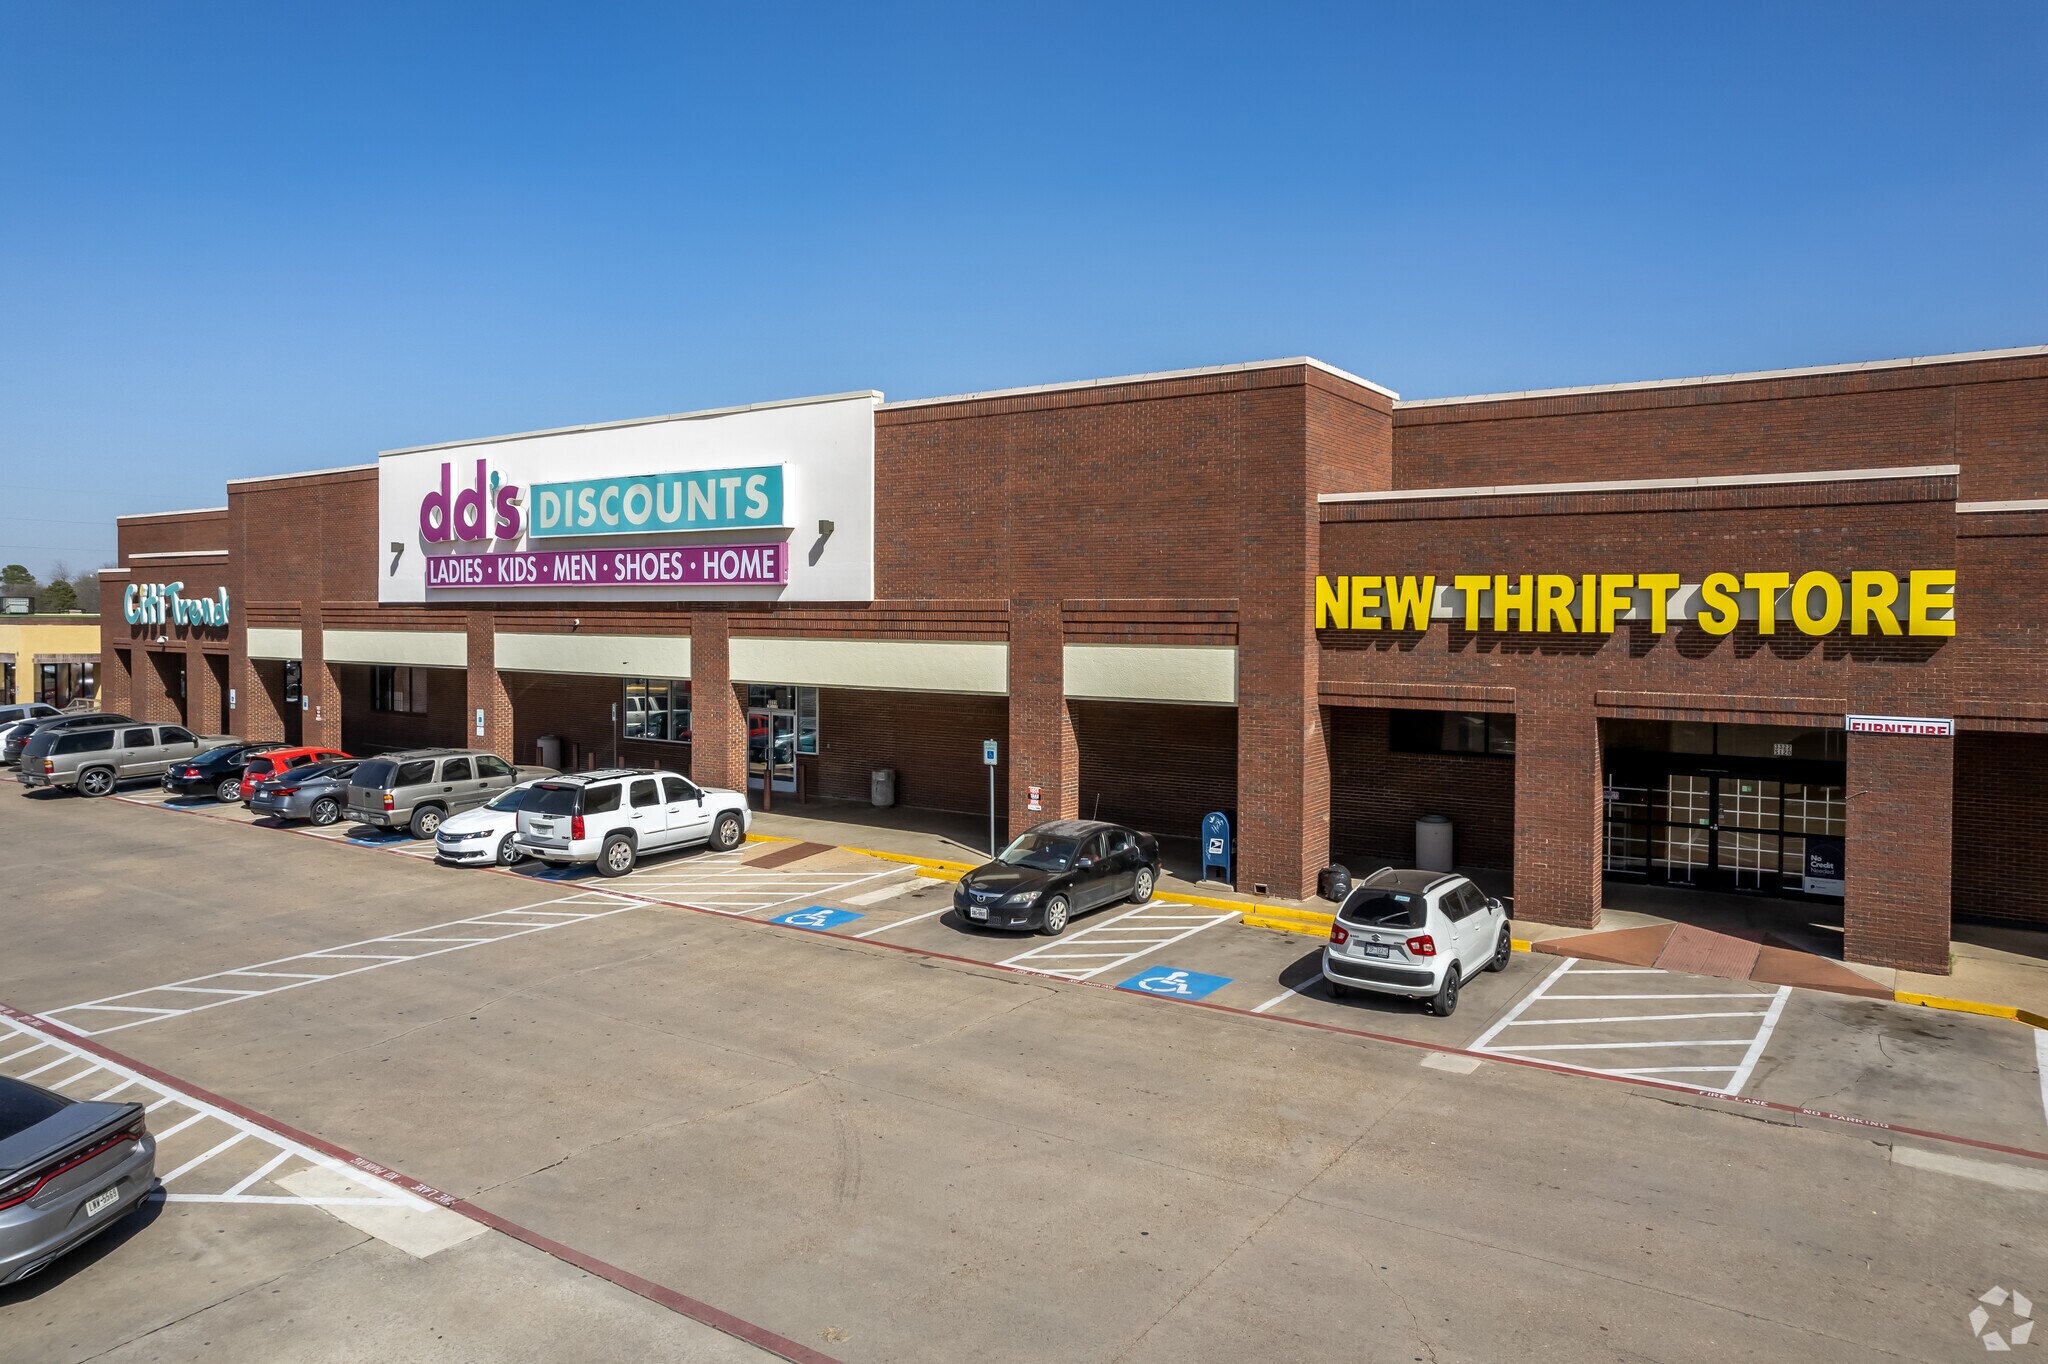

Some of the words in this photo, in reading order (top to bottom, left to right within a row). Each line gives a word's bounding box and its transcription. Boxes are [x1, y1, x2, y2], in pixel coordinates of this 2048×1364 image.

[420, 458, 524, 543] dd's
[540, 474, 769, 529] DISCOUNTS
[430, 558, 483, 583] LADIES
[498, 556, 537, 582] KIDS
[553, 554, 597, 582] MEN
[614, 552, 683, 581] SHOES
[703, 550, 775, 580] HOME
[124, 583, 165, 625] Citi
[1315, 575, 1436, 631] NEW
[1454, 574, 1680, 634] THRIFT
[1697, 569, 1957, 637] STORE
[1810, 854, 1822, 862] No
[1810, 861, 1834, 869] Credit
[1699, 1090, 1728, 1100] FIRE
[1734, 1095, 1769, 1107] LANE
[1803, 1108, 1821, 1117] NO
[1828, 1112, 1890, 1129] PARKING
